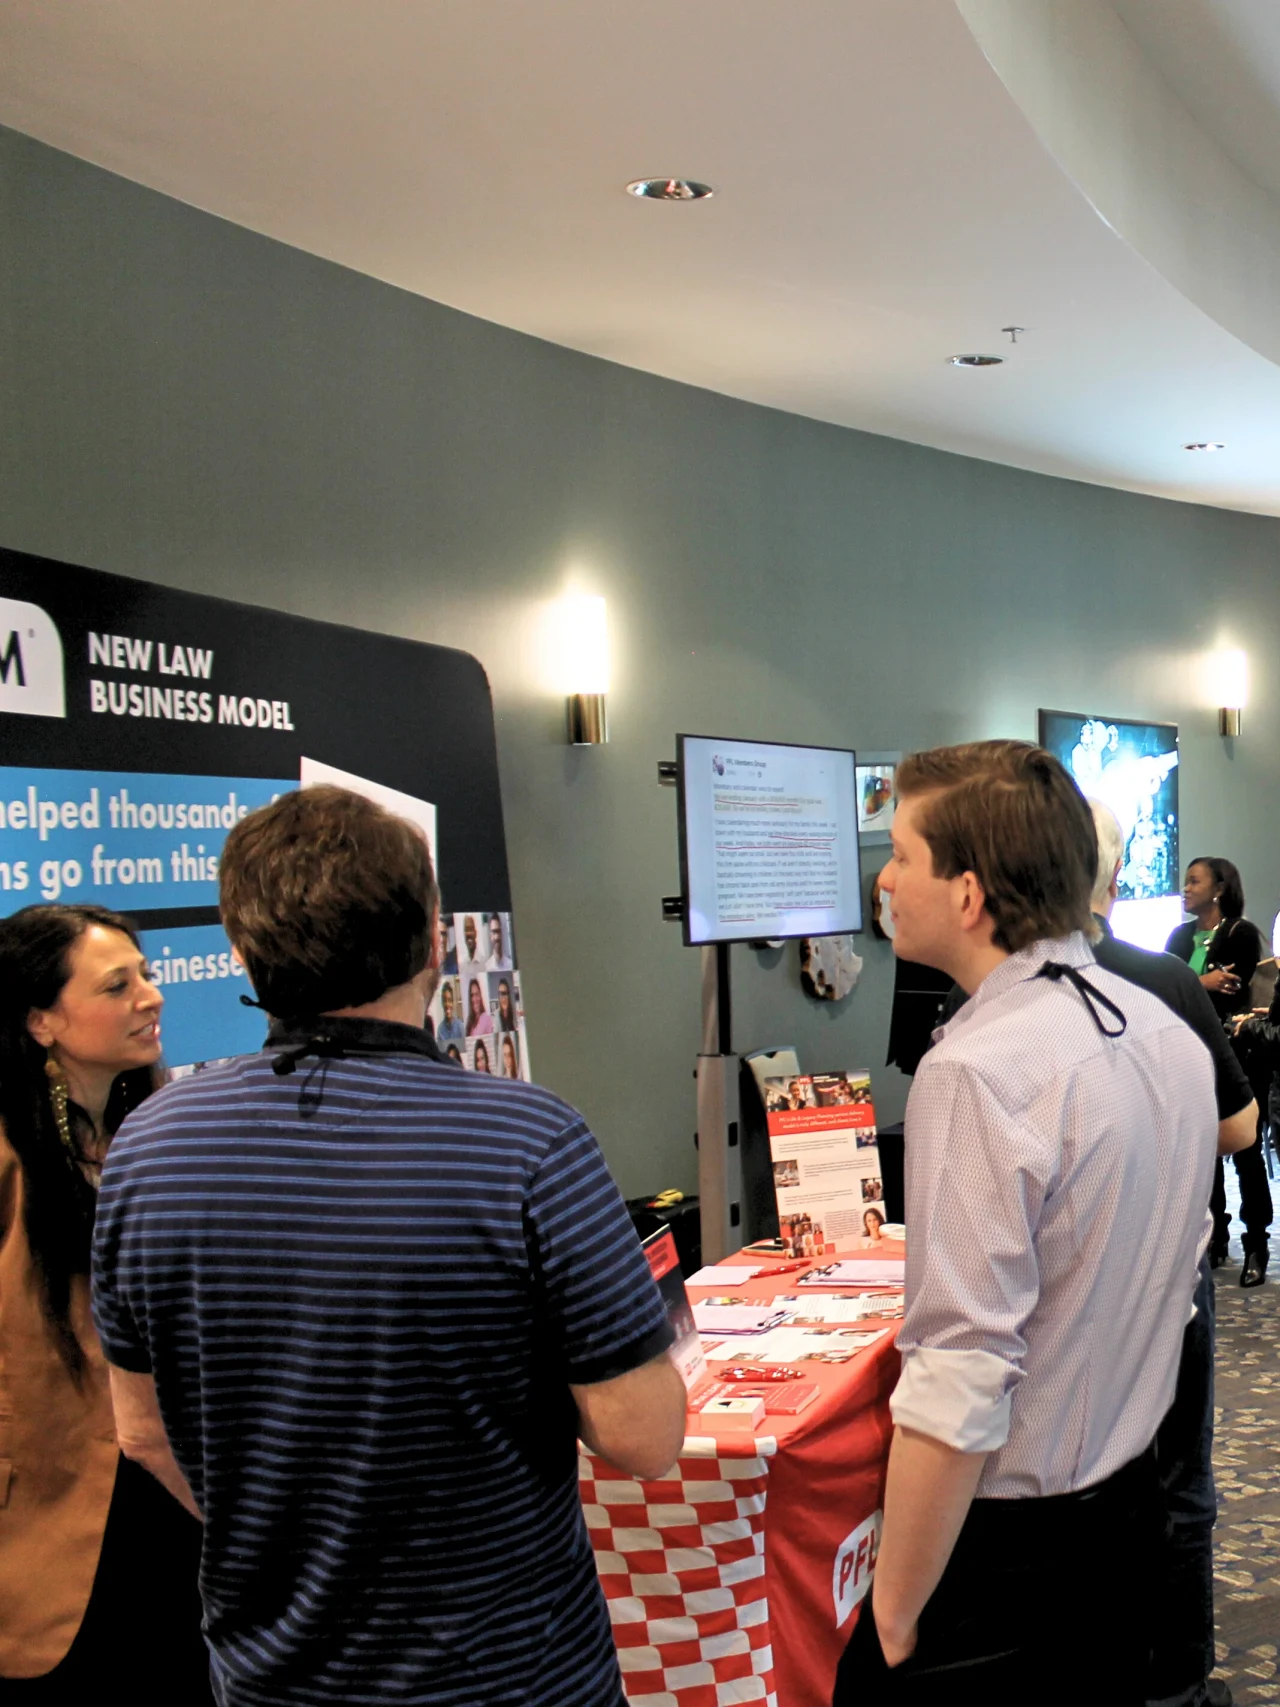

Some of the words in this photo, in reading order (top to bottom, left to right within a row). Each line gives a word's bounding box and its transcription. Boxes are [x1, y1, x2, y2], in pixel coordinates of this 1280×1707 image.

[88, 632, 153, 671] NEW
[158, 644, 213, 679] LAW
[90, 680, 212, 725] BUSINESS
[218, 696, 294, 732] MODEL
[109, 789, 248, 829] thousands
[40, 860, 83, 901] go
[91, 844, 163, 886] from
[170, 844, 219, 882] this
[149, 946, 245, 986] sinesse
[838, 1527, 878, 1602] PFL
